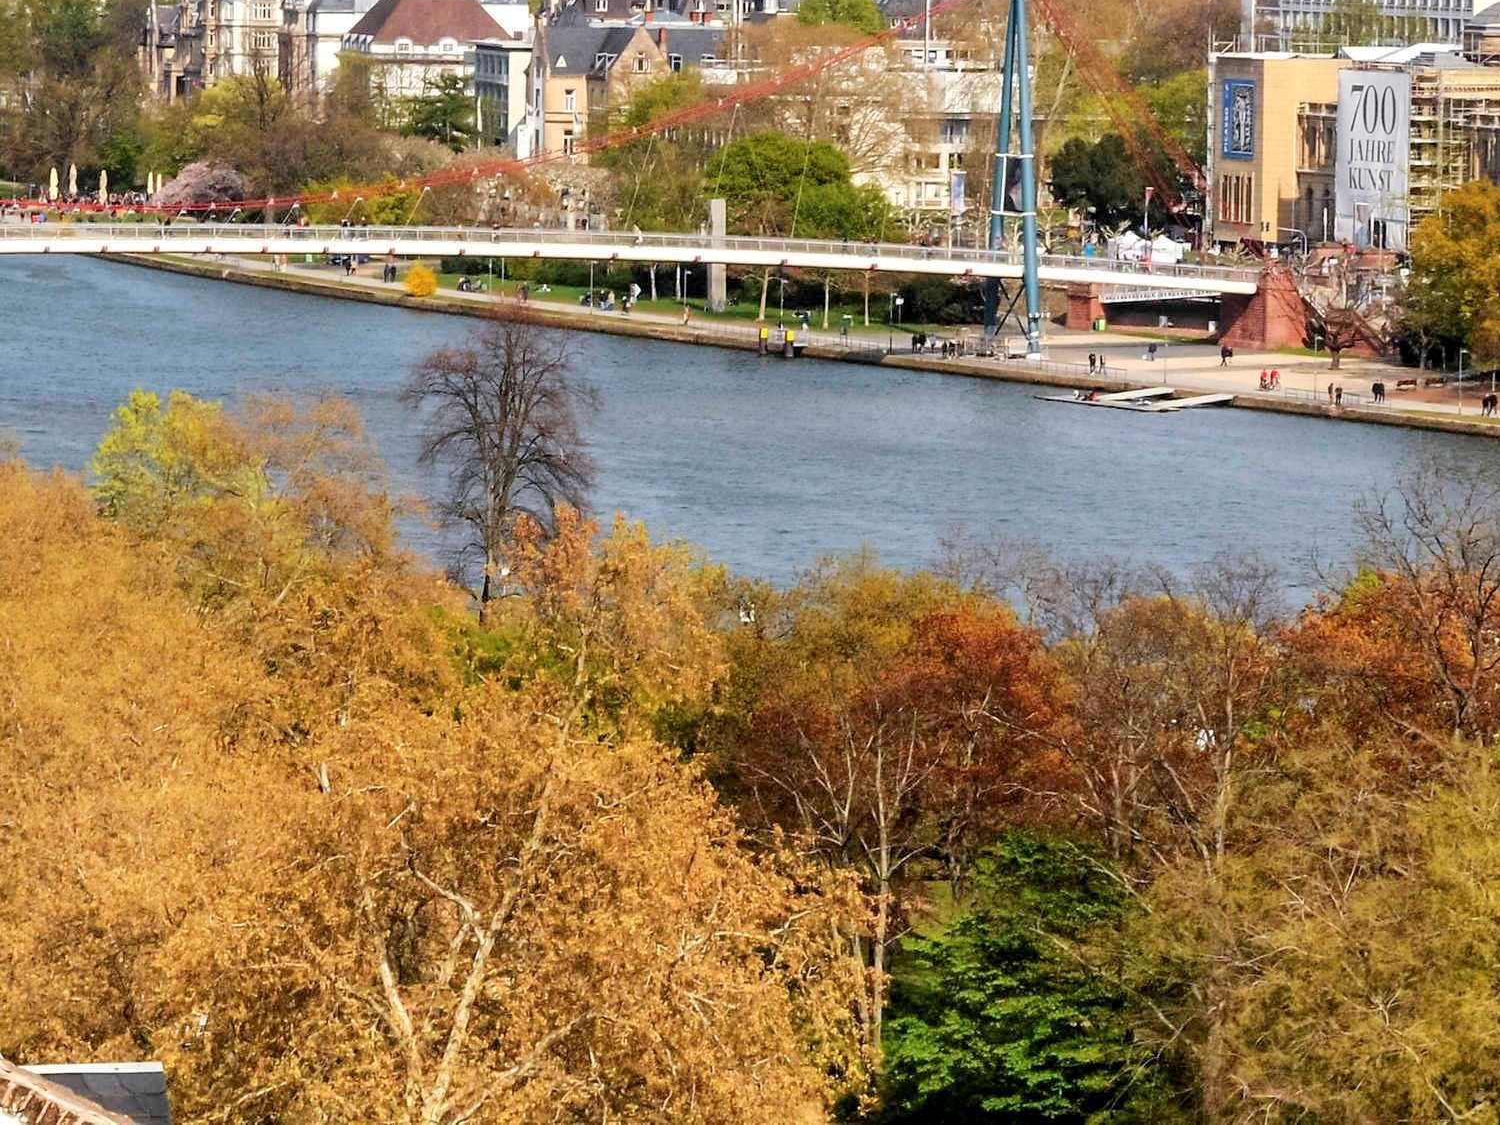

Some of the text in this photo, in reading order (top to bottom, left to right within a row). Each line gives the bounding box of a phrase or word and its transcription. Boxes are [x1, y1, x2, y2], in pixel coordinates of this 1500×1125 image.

[1350, 85, 1396, 135] 700
[1348, 138, 1395, 165] JAHRE
[1348, 166, 1394, 193] KUNST
